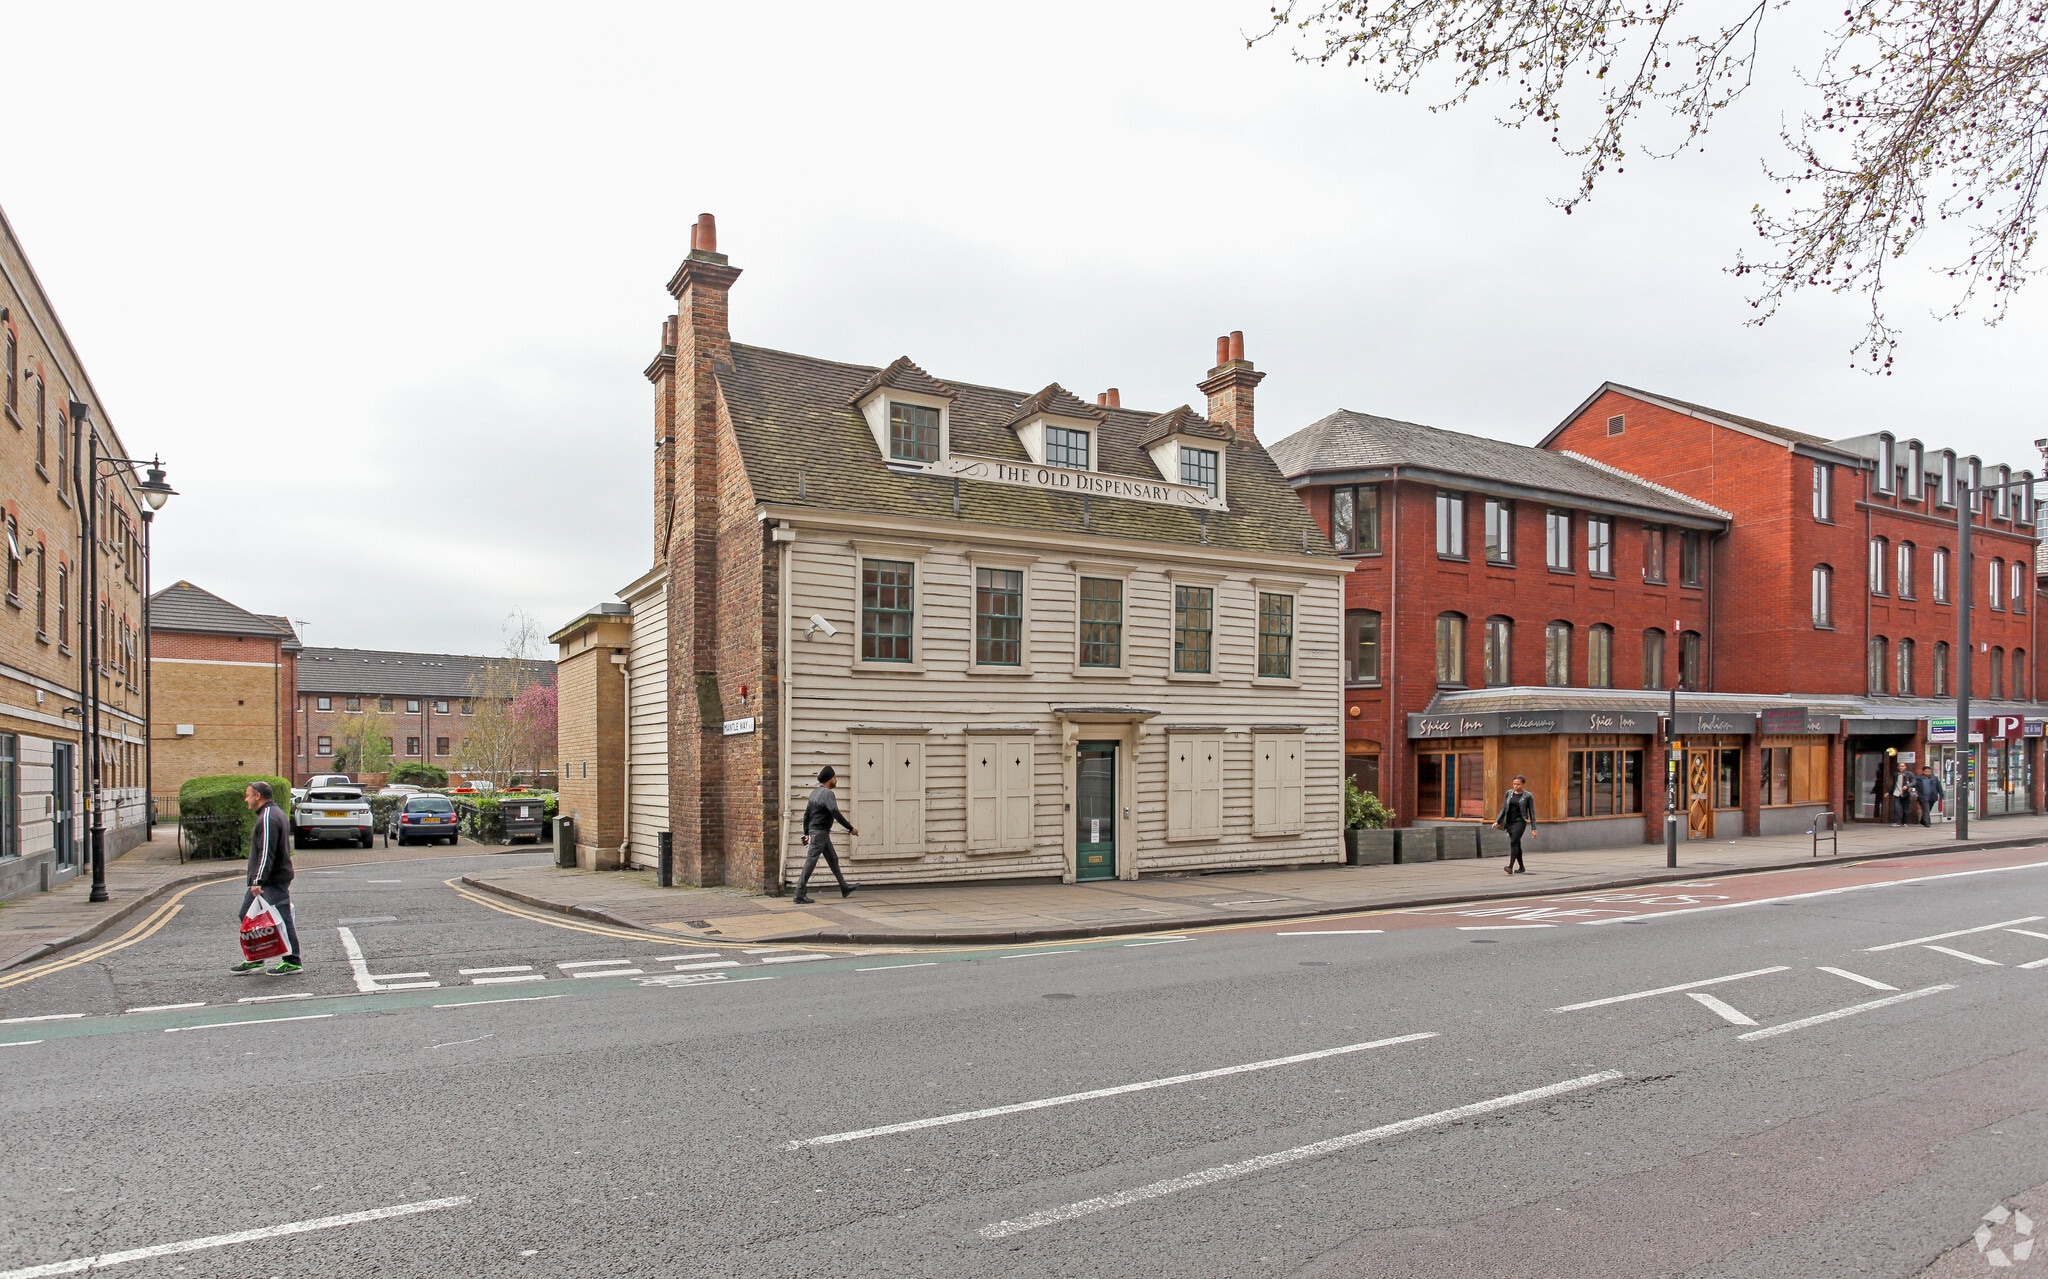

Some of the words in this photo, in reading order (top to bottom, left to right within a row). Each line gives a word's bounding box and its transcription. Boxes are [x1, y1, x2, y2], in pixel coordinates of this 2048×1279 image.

[996, 463, 1030, 483] THE
[1037, 469, 1070, 488] OLD
[1076, 474, 1171, 500] DISPENSARY
[740, 721, 749, 730] WAY
[1419, 719, 1451, 735] Spice
[1460, 718, 1484, 733] Inn
[1505, 716, 1557, 733] Takeaway
[1590, 713, 1613, 731] Spice
[1619, 714, 1636, 730] Inn
[1697, 714, 1734, 732] Indian
[1996, 716, 2019, 738] P
[240, 926, 275, 941] wilko
